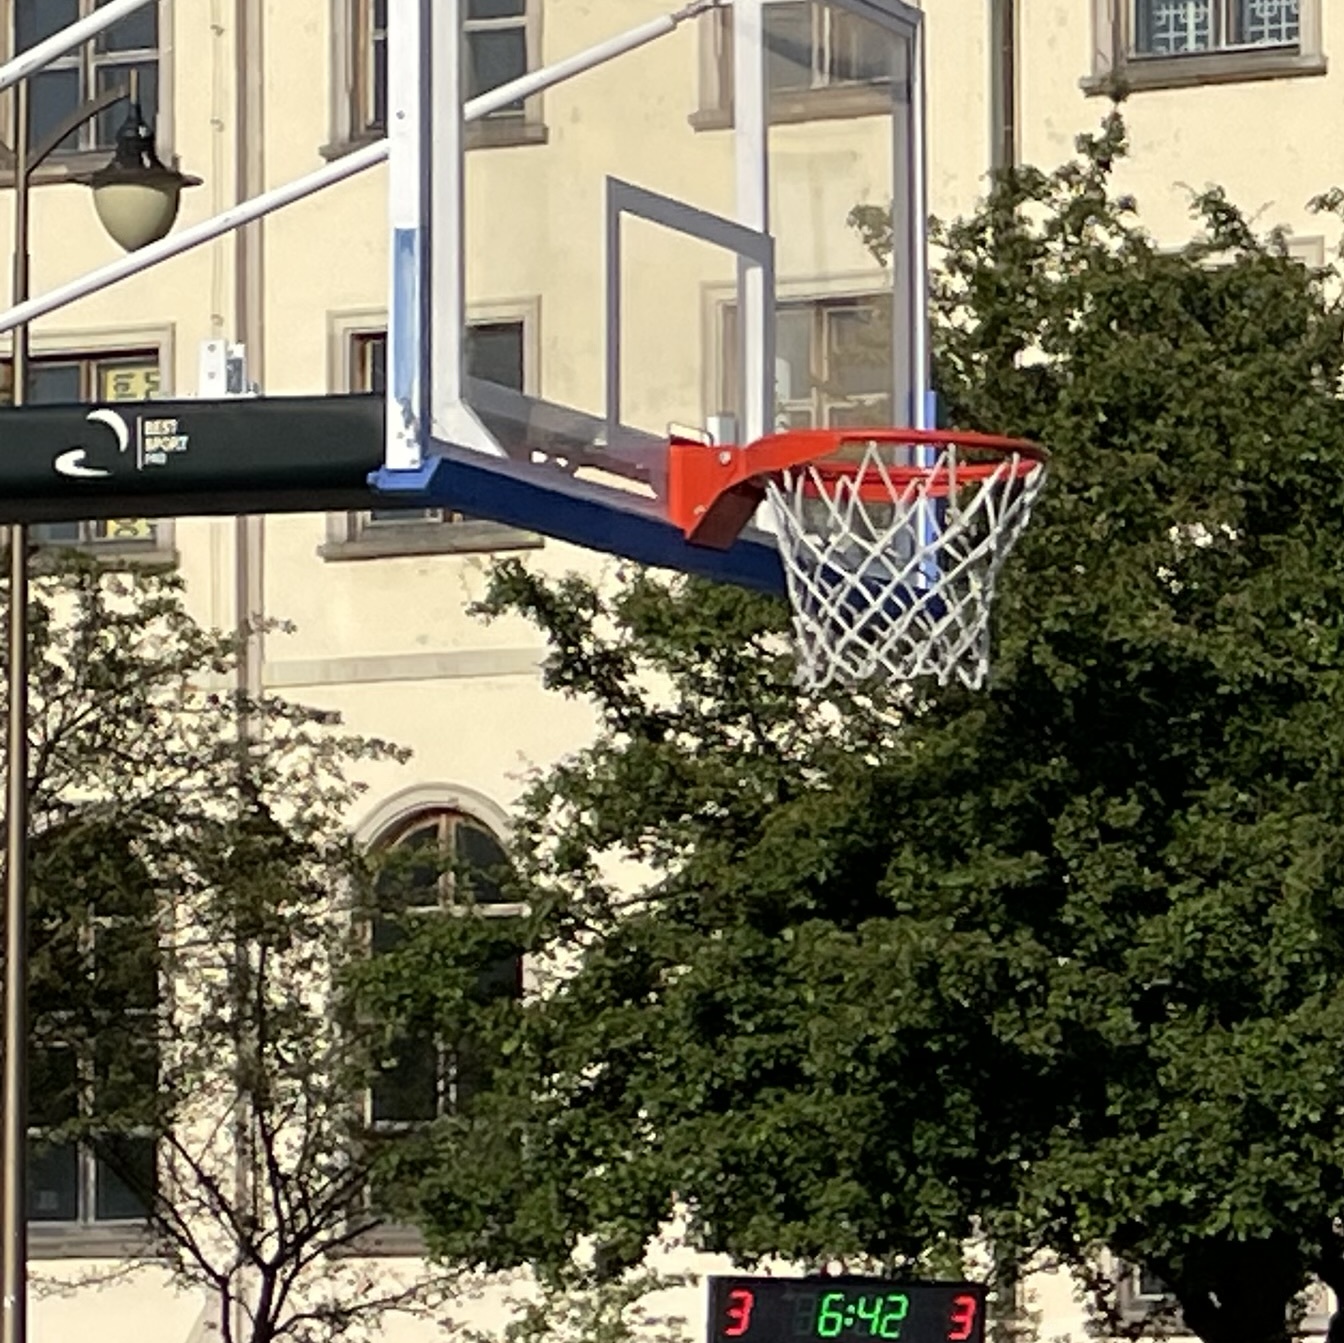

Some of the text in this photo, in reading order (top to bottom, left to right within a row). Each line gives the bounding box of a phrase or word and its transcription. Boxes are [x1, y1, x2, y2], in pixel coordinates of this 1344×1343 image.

[724, 1290, 754, 1336] 3
[817, 1293, 909, 1338] 6:42
[947, 1296, 976, 1341] 3
